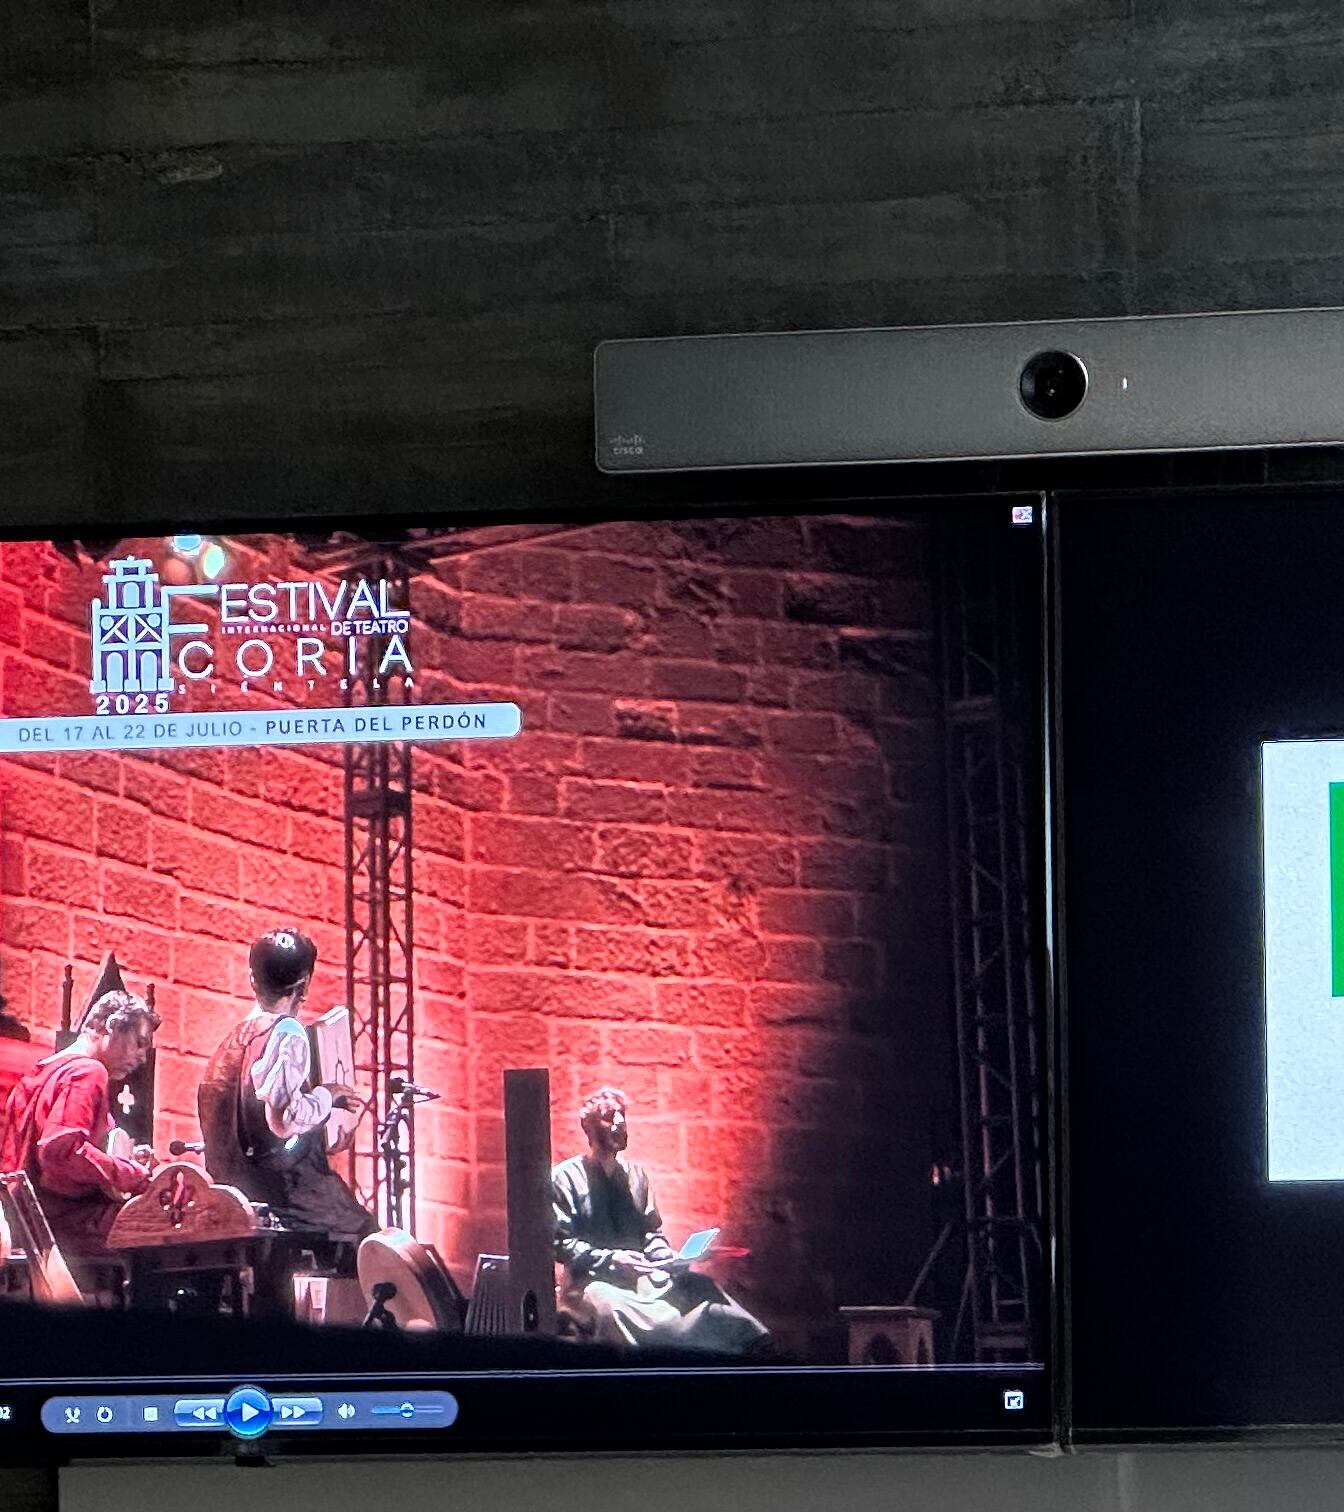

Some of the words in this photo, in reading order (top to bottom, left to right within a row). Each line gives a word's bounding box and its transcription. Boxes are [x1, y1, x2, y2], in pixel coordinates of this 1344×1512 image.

[161, 579, 411, 633] FESTIVAL
[331, 621, 352, 636] DE
[356, 619, 409, 635] TEATRO
[178, 635, 414, 680] CORIA
[96, 693, 169, 715] 2025
[19, 727, 54, 743] DEL
[64, 726, 84, 741] 17
[92, 725, 115, 740] AL
[124, 724, 146, 739] 22
[154, 723, 177, 739] DE
[186, 721, 242, 738] JULIO
[265, 718, 345, 735] PUERTA
[355, 717, 393, 733] DEL
[401, 711, 486, 731] PERDÓN
